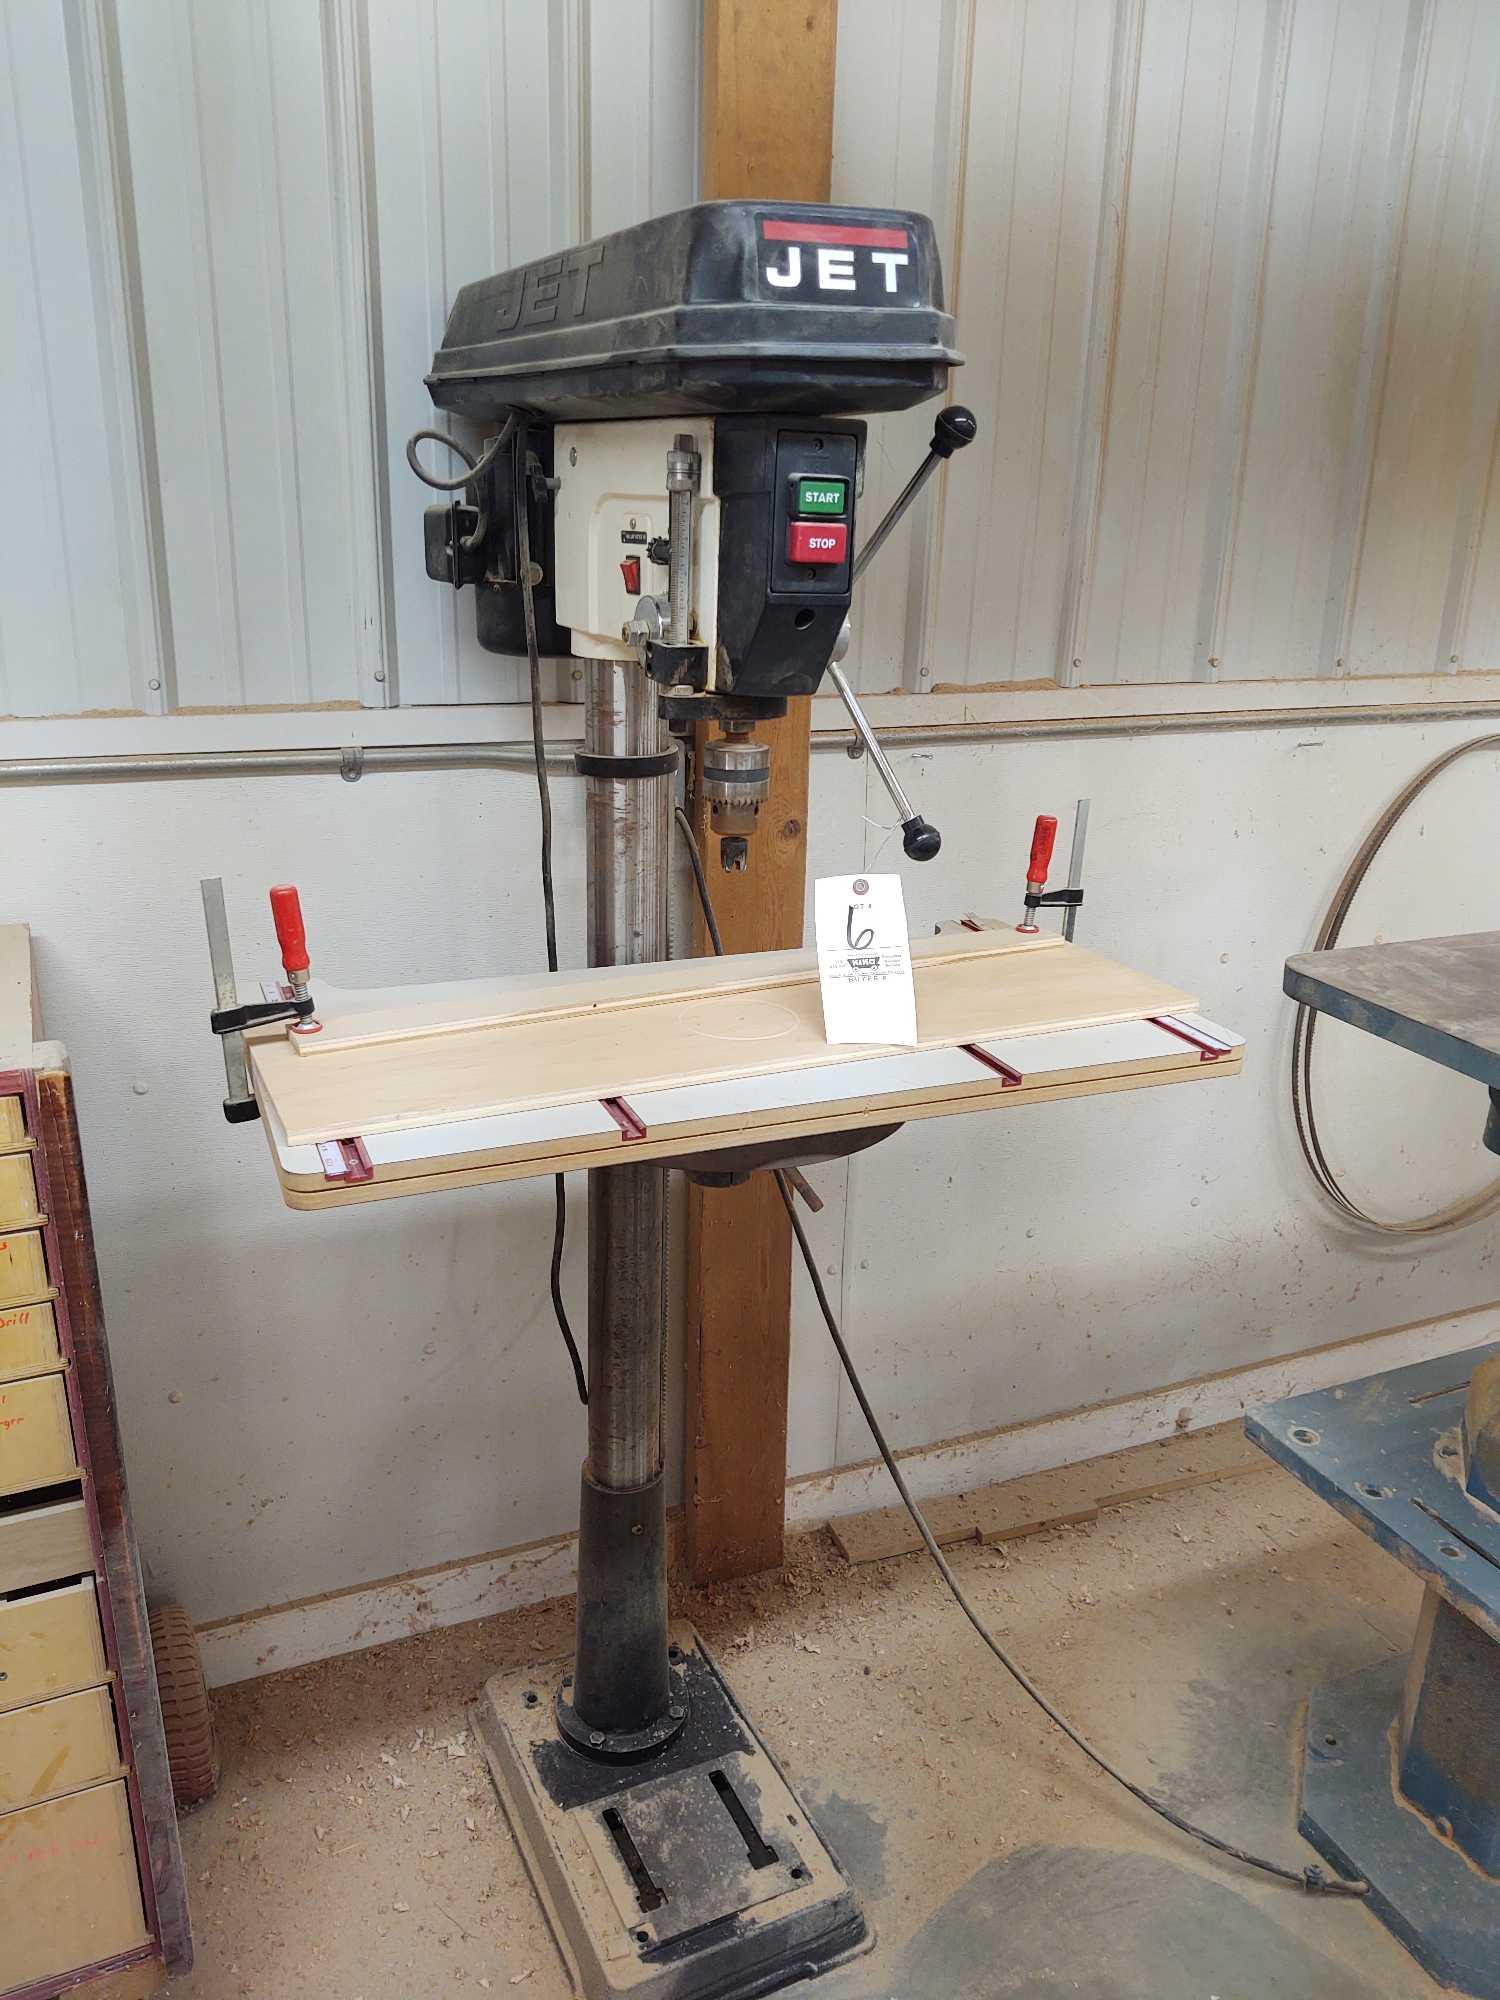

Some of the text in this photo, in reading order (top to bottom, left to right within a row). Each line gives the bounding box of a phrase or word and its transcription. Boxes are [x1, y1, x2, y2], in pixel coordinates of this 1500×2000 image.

[496, 245, 606, 333] JET
[765, 247, 909, 293] JET
[805, 491, 840, 504] START
[808, 537, 837, 549] STOP
[846, 904, 875, 951] 6
